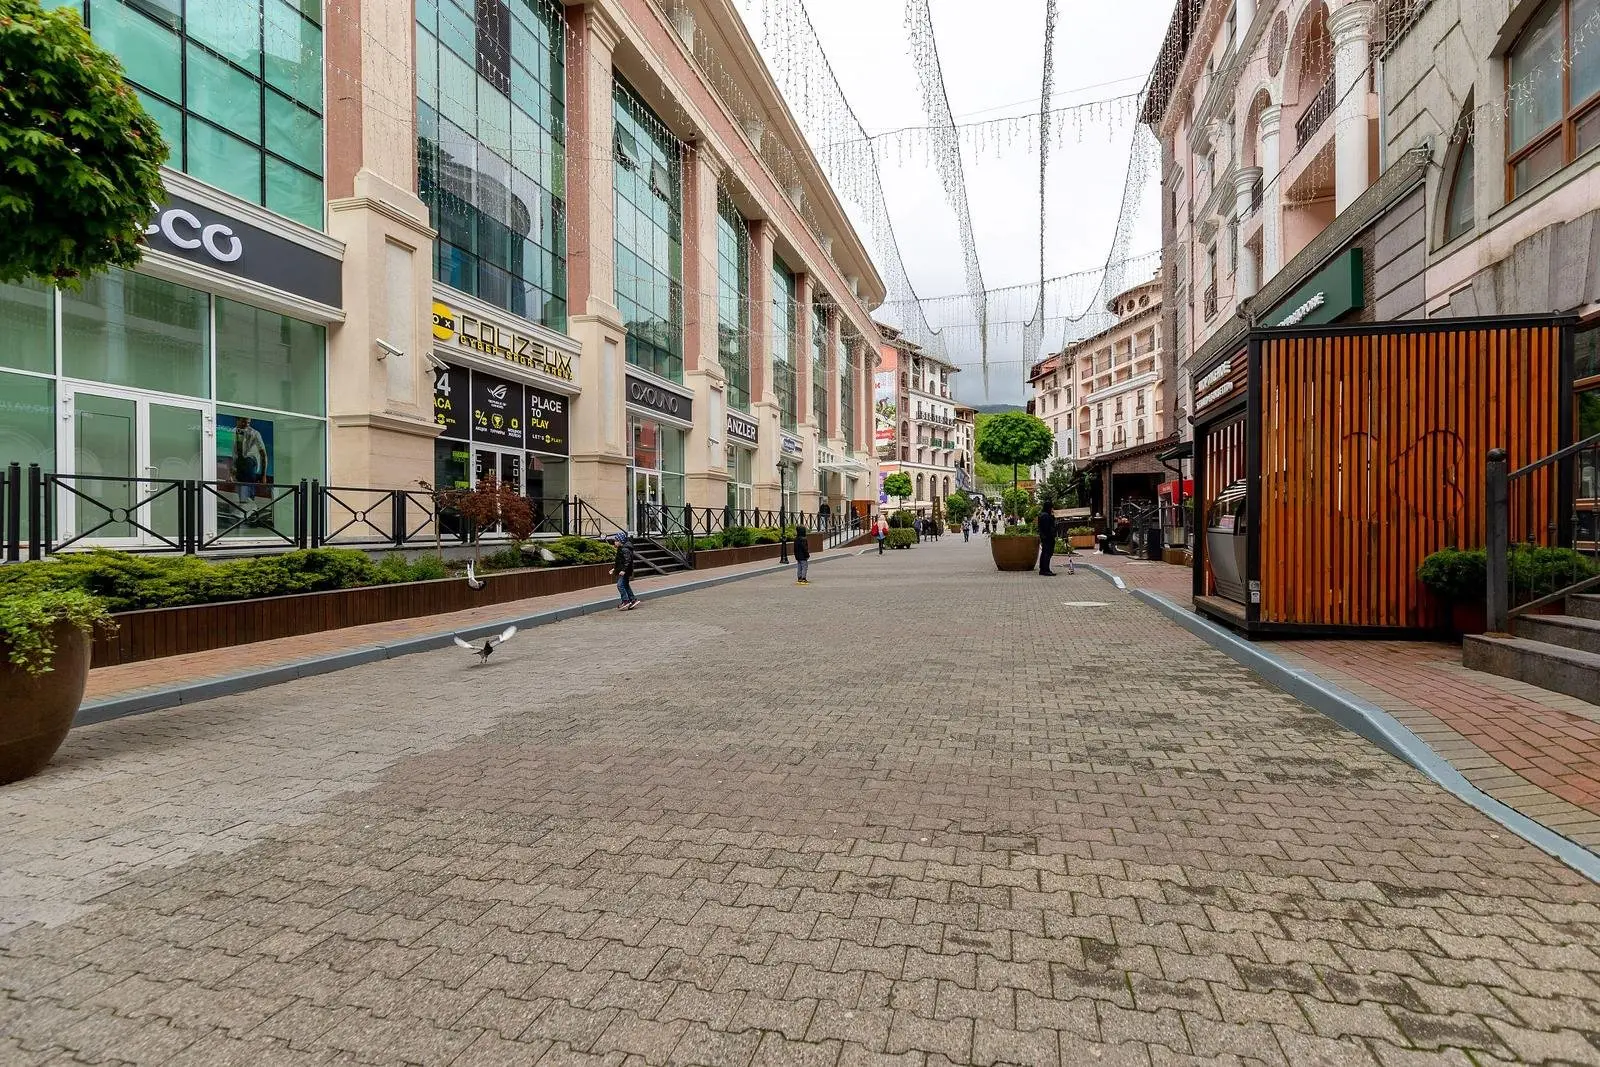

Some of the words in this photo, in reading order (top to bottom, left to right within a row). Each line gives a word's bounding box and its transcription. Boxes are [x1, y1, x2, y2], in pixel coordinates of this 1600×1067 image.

[459, 335, 498, 355] CYBER
[505, 350, 538, 369] SPORT
[543, 364, 573, 381] ARENA
[434, 372, 451, 396] 4
[531, 395, 562, 413] PLACE
[531, 407, 542, 418] TO
[531, 417, 549, 429] PLAY
[727, 417, 756, 440] ANZLER
